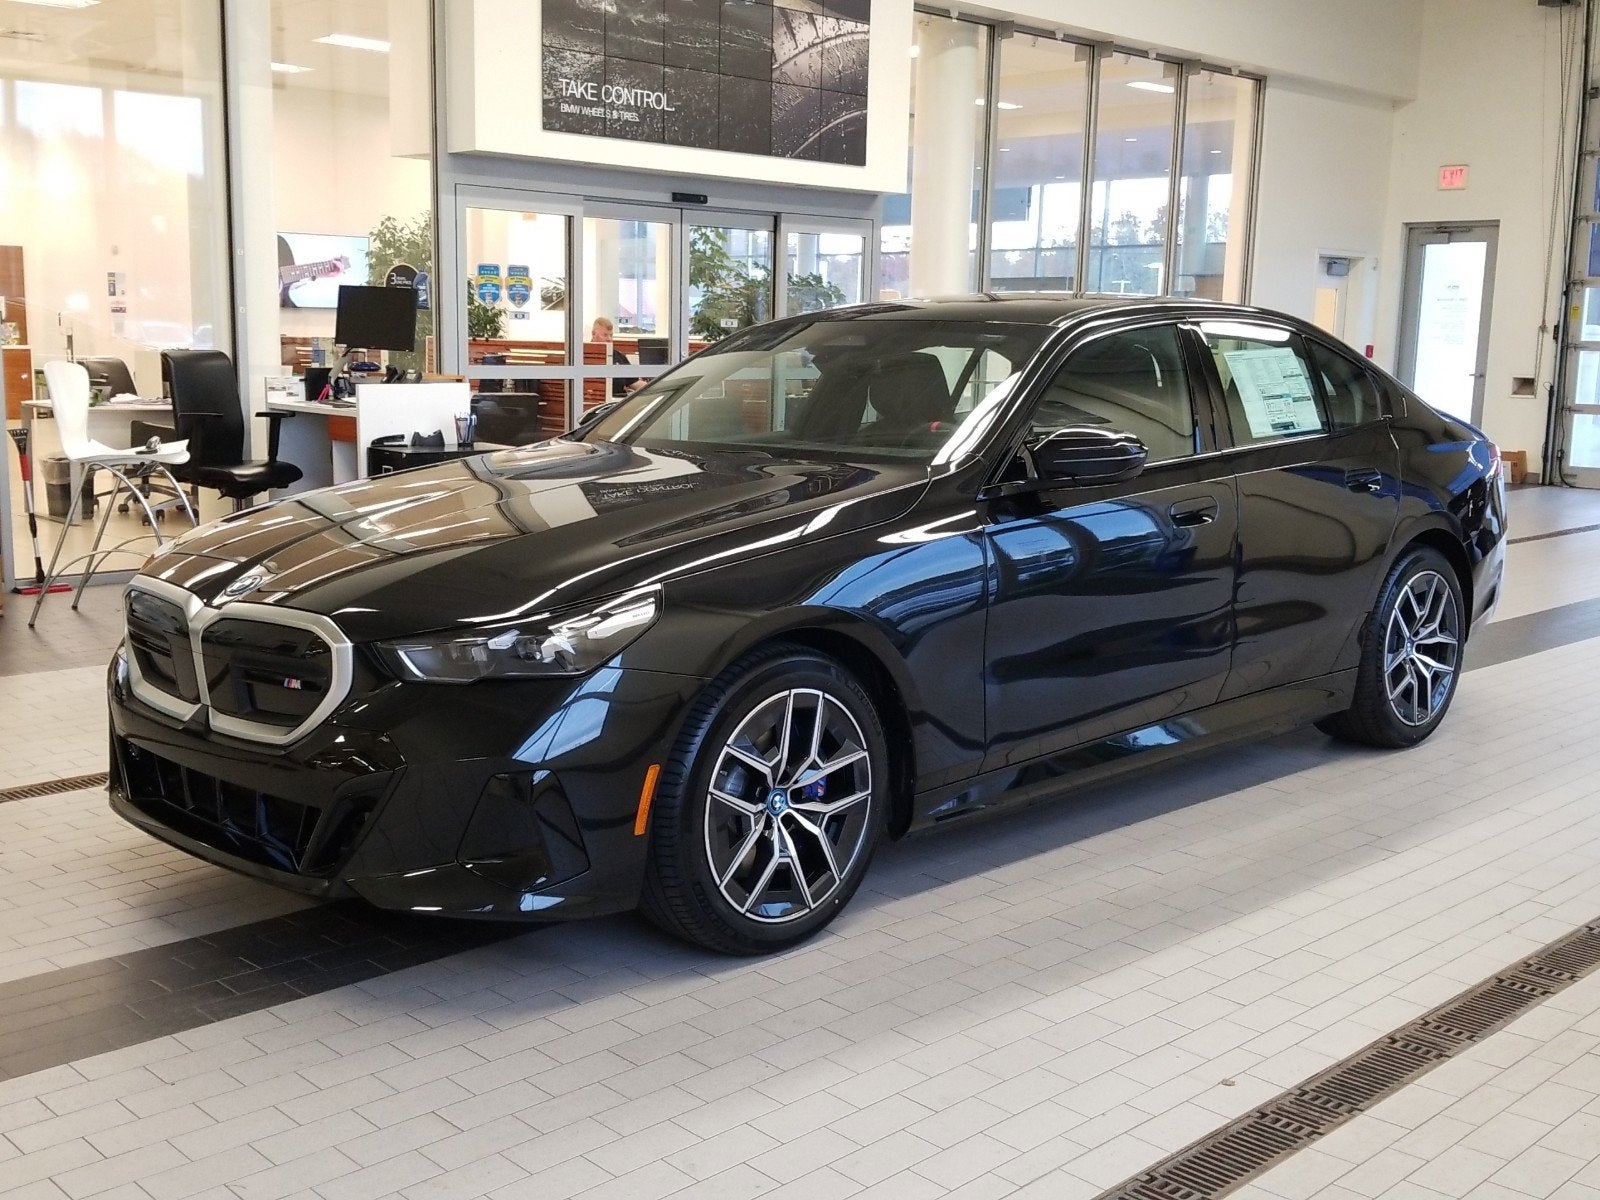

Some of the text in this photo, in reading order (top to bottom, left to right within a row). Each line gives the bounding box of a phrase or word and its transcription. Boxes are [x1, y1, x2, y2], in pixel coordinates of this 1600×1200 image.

[559, 78, 675, 111] TAKE CONTROL.
[561, 102, 580, 114] BMW
[581, 105, 612, 119] WHEELS
[612, 109, 618, 119] &
